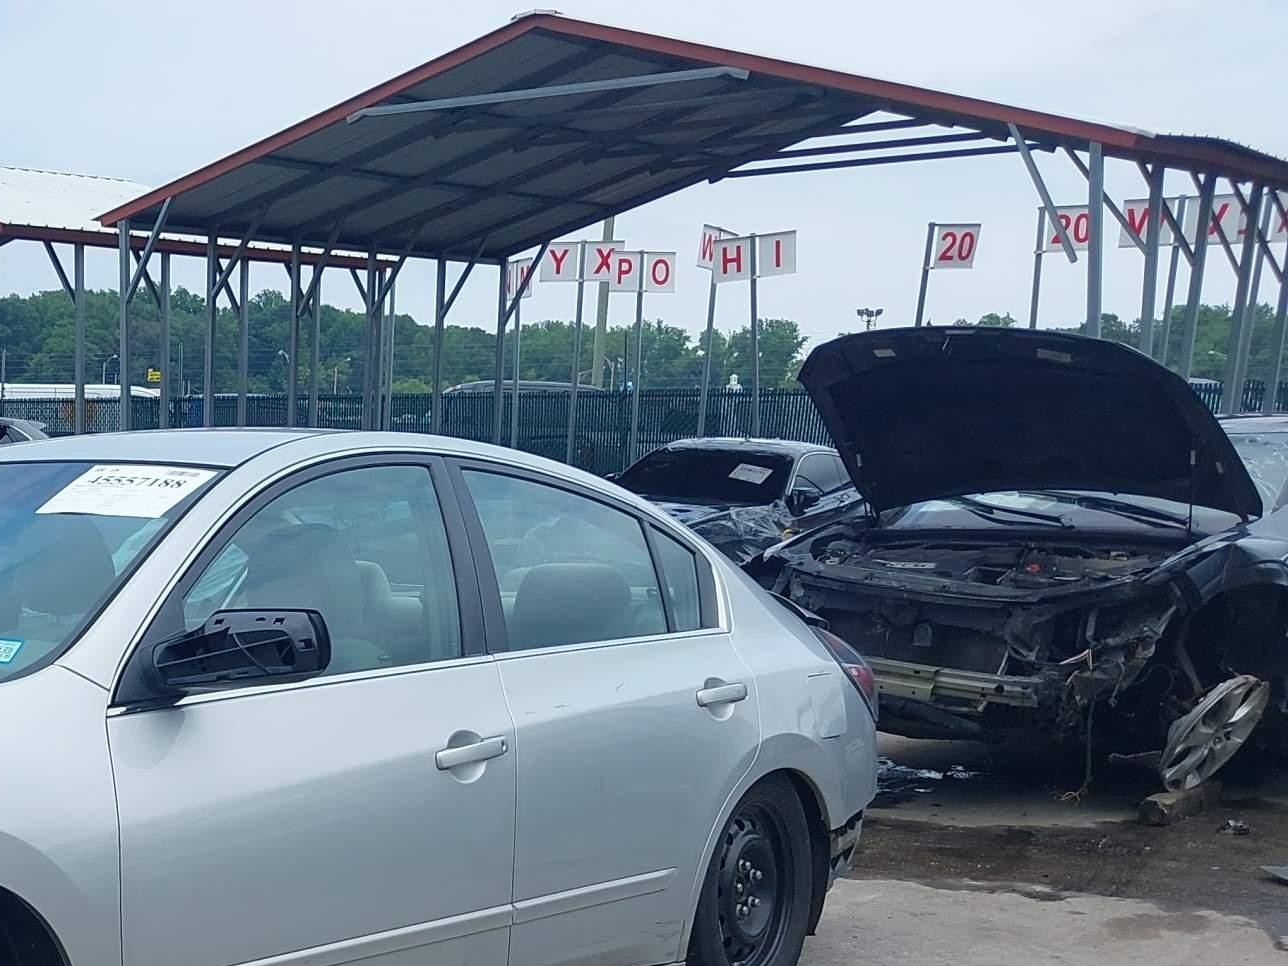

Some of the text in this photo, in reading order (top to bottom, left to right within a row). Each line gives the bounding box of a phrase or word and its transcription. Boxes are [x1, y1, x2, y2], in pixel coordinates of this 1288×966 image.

[722, 245, 741, 274] H
[776, 239, 781, 268] I
[938, 231, 975, 261] 20
[550, 249, 569, 274] Y
[594, 247, 615, 274] X
[617, 258, 633, 284] P
[652, 258, 670, 286] O
[87, 475, 188, 489] 45557188
